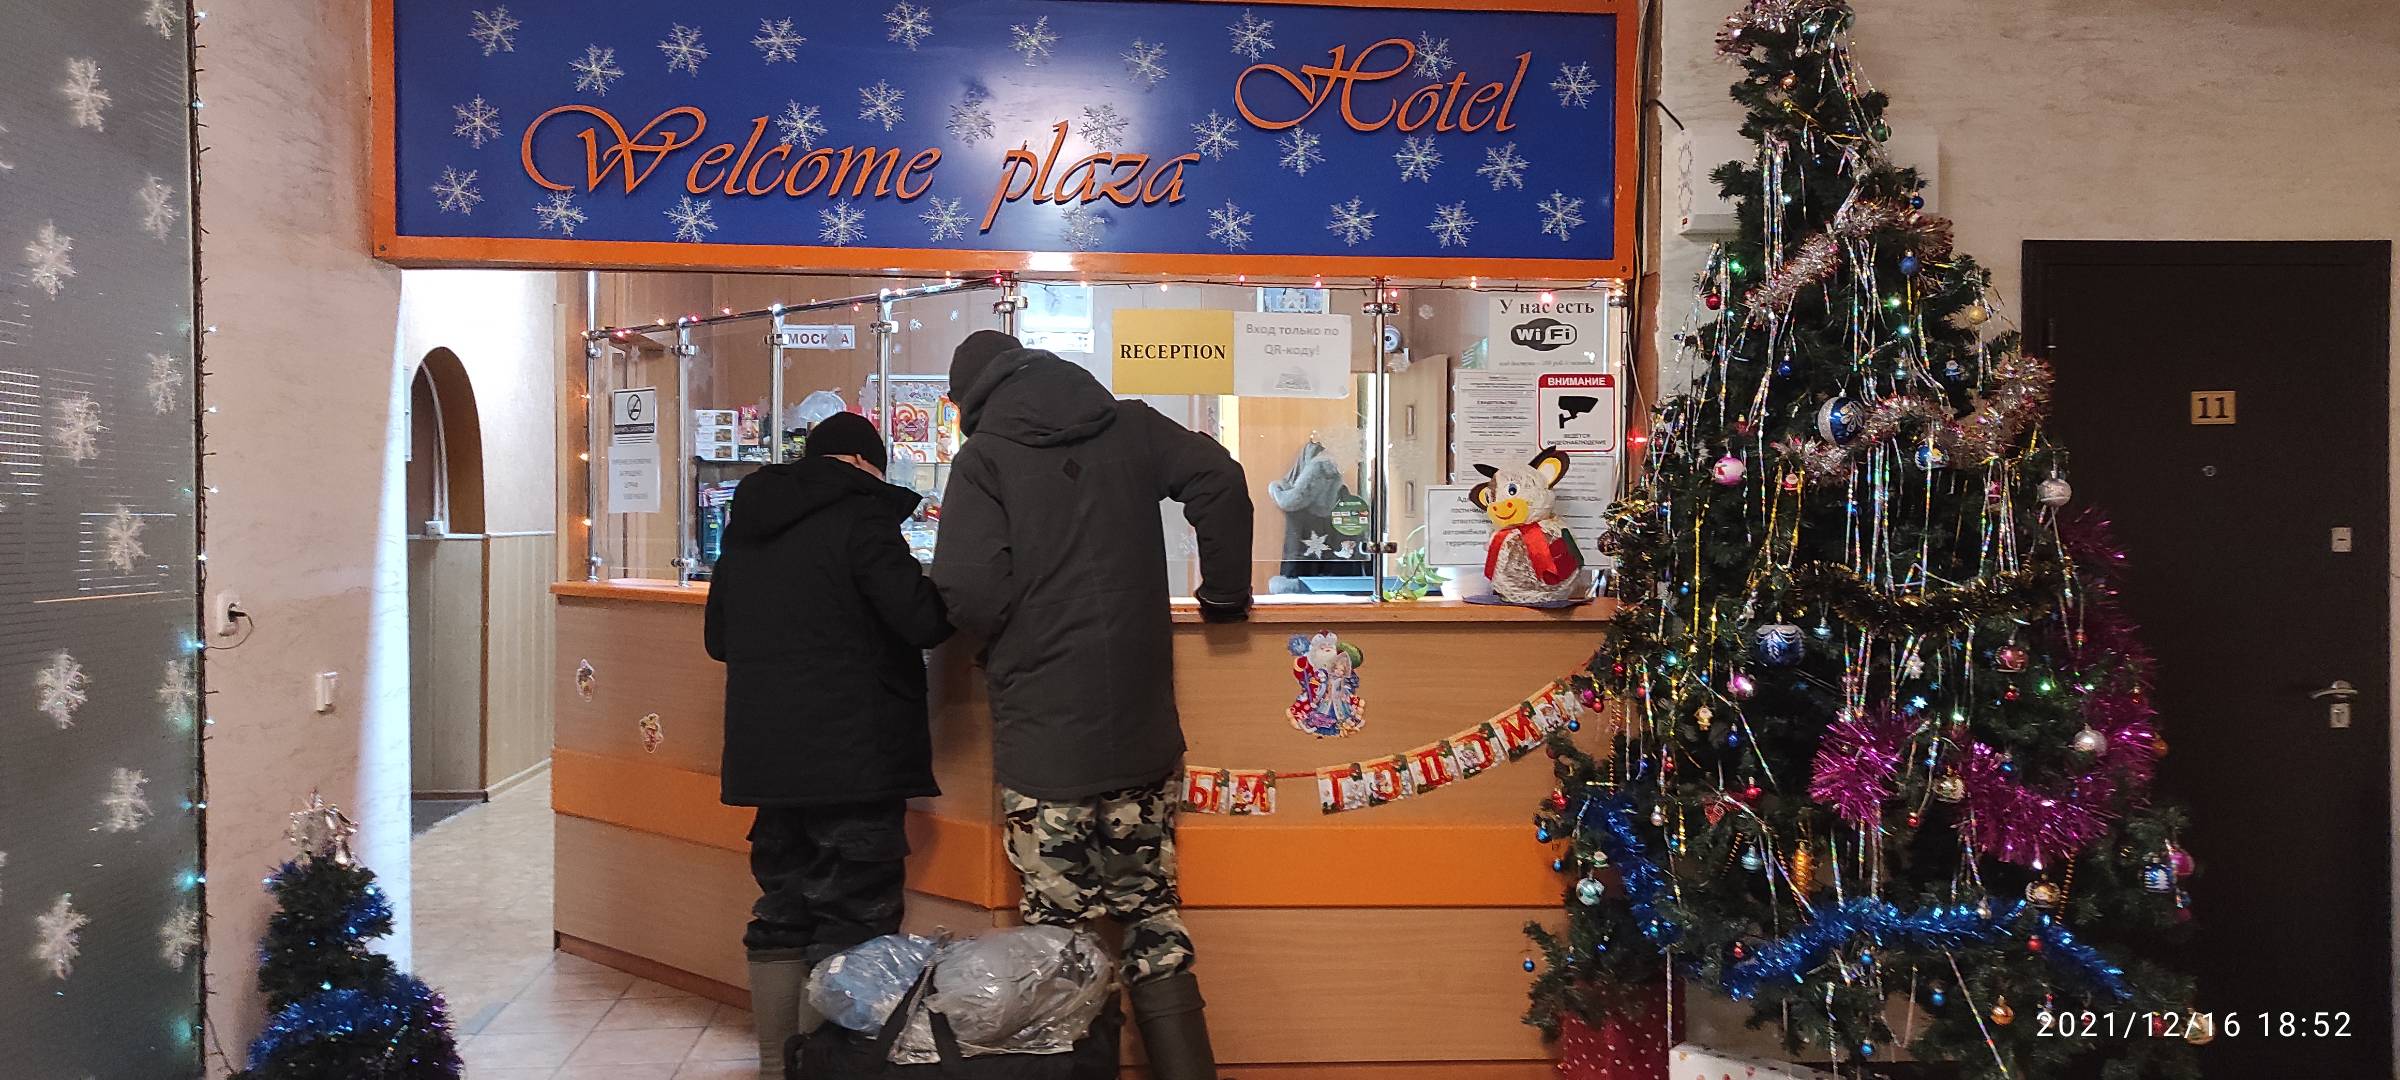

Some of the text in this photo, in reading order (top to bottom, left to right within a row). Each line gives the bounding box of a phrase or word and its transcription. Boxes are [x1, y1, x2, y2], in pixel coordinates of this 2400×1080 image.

[1234, 37, 1532, 133] Hotel
[520, 103, 1201, 233] Welcome plaza
[1500, 299, 1595, 315] У нас есть
[1246, 323, 1339, 337] Вход только по
[788, 333, 850, 345] МОСКА
[1120, 344, 1226, 360] RECEPTION
[1264, 344, 1320, 357] QR-коду!
[1547, 377, 1606, 386] ВНИМАНИЕ
[2198, 396, 2230, 419] 11
